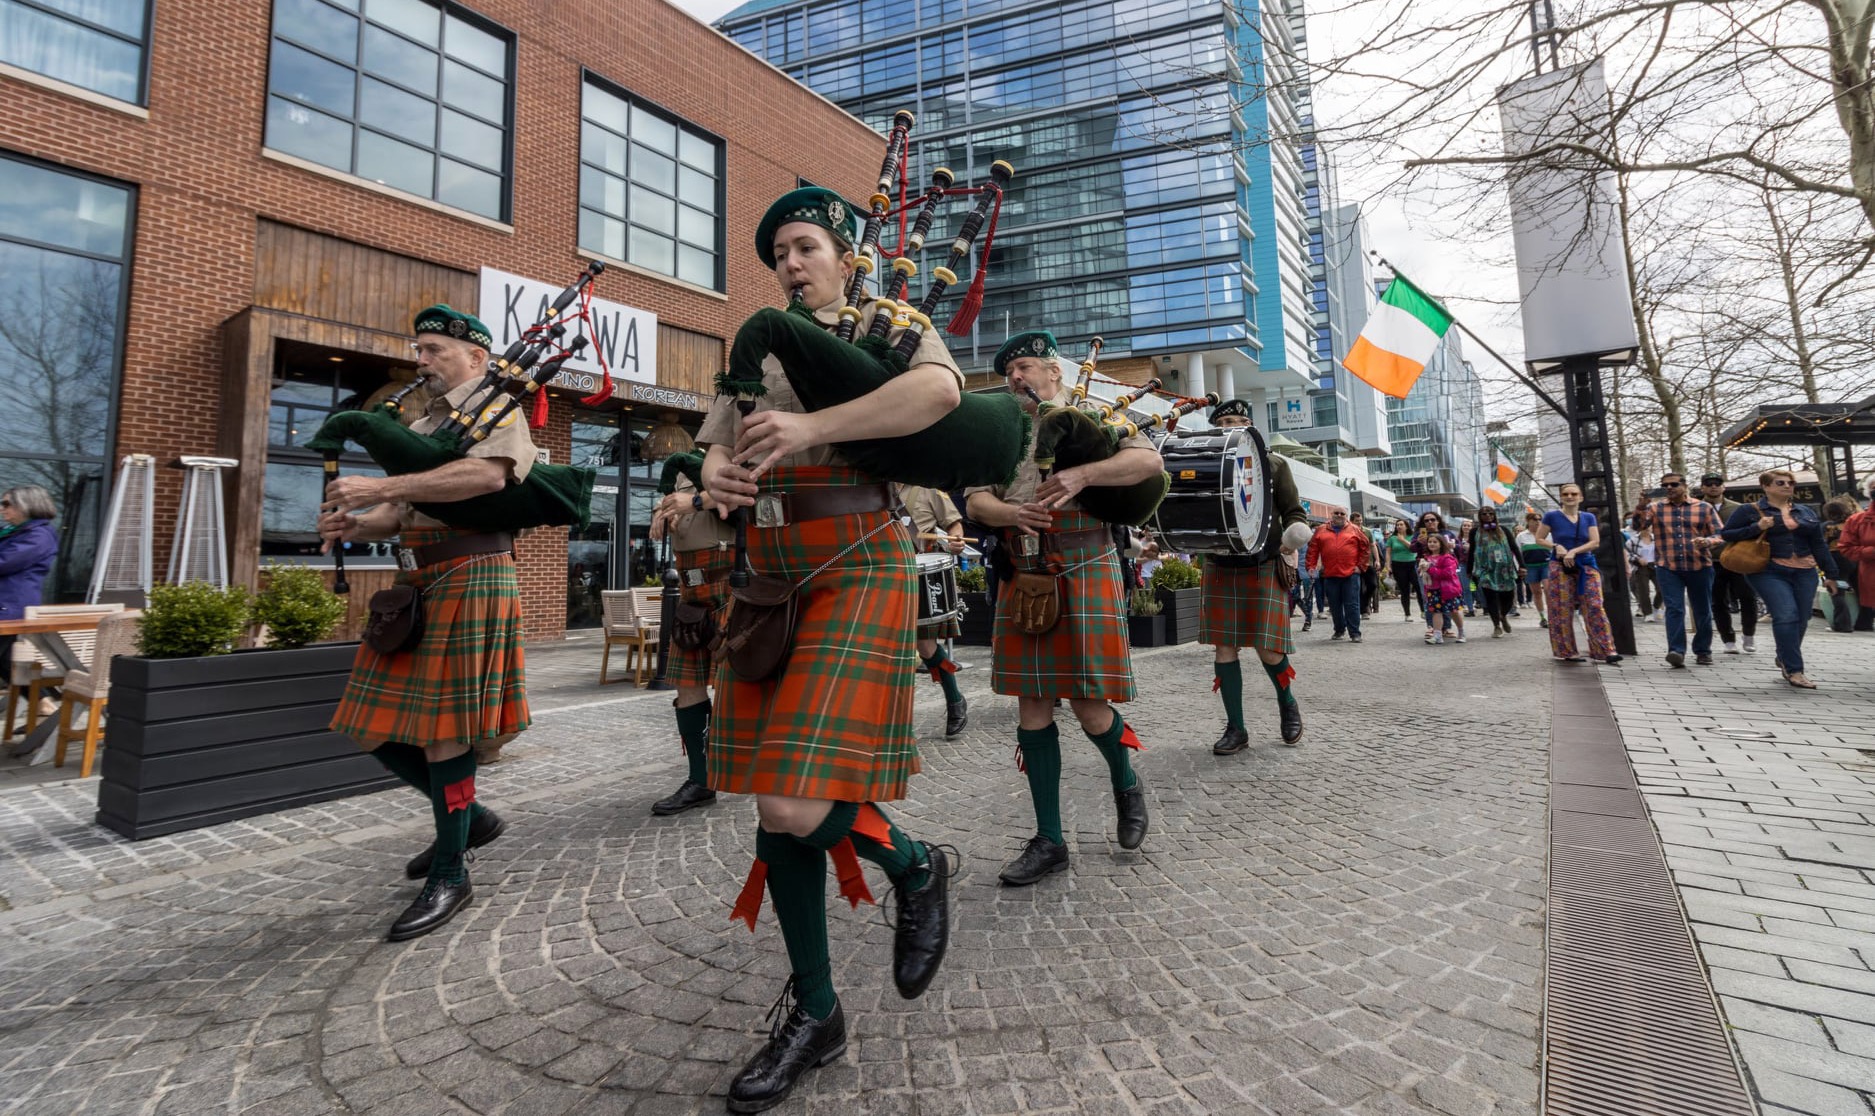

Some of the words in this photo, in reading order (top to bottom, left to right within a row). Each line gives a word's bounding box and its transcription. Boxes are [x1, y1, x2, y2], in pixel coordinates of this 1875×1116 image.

[632, 385, 697, 409] KOREAN
[1282, 412, 1306, 420] HYATT
[588, 455, 604, 466] 751
[1743, 490, 1814, 503] KIRN'S
[928, 580, 943, 613] Pearl
